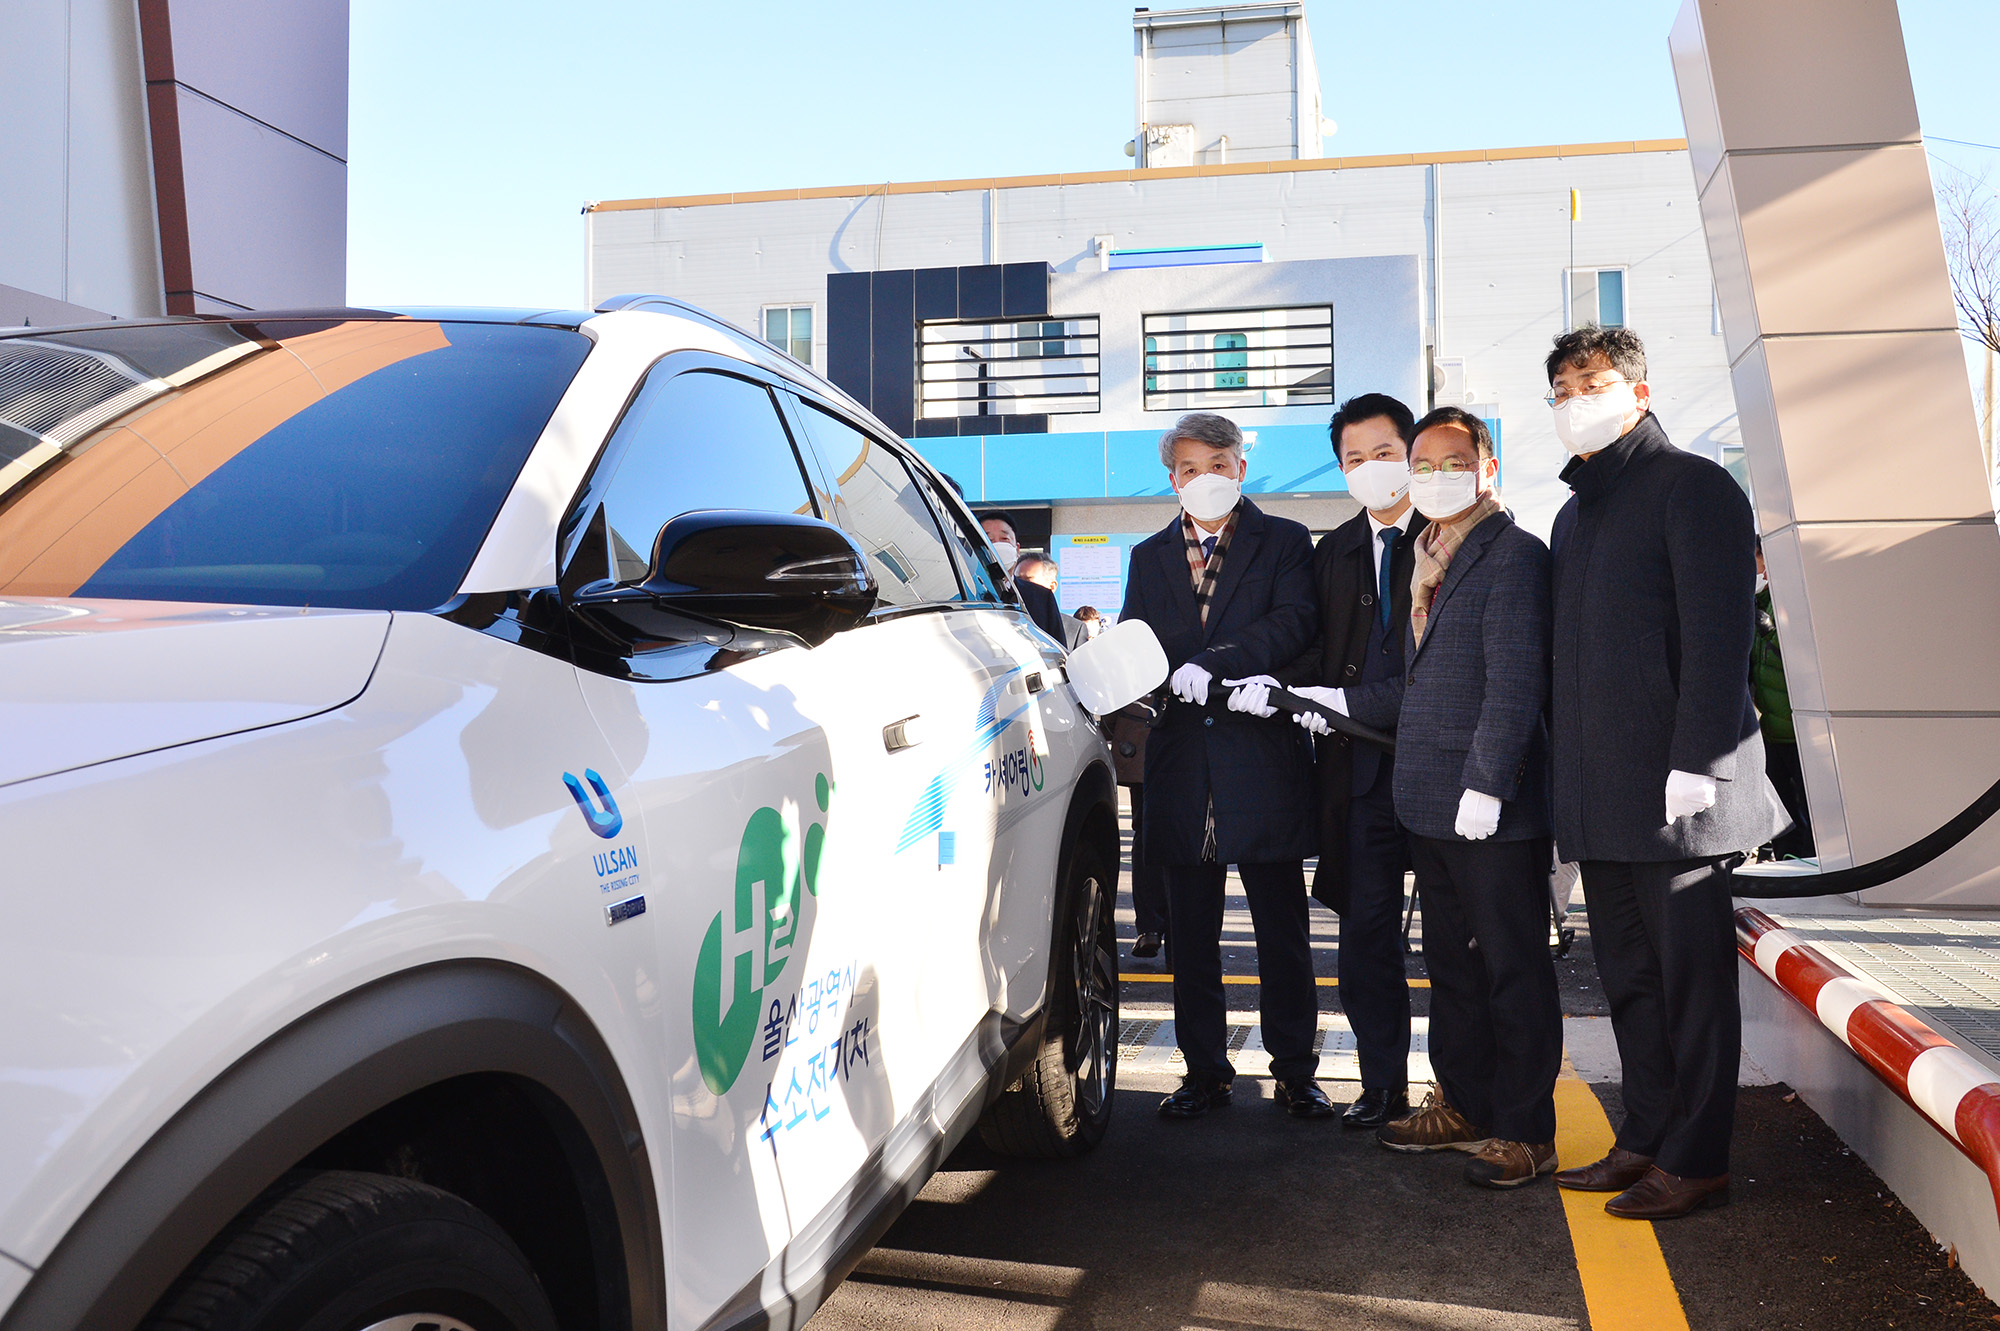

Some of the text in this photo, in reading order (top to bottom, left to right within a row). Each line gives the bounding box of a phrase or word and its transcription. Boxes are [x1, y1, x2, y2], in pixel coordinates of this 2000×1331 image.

[984, 746, 1030, 798] 카셰어링
[593, 845, 638, 877] ULSAN
[600, 873, 640, 894] THE RISING CITY
[763, 959, 857, 1062] 울산광역시
[760, 1017, 870, 1160] 수소전기차
